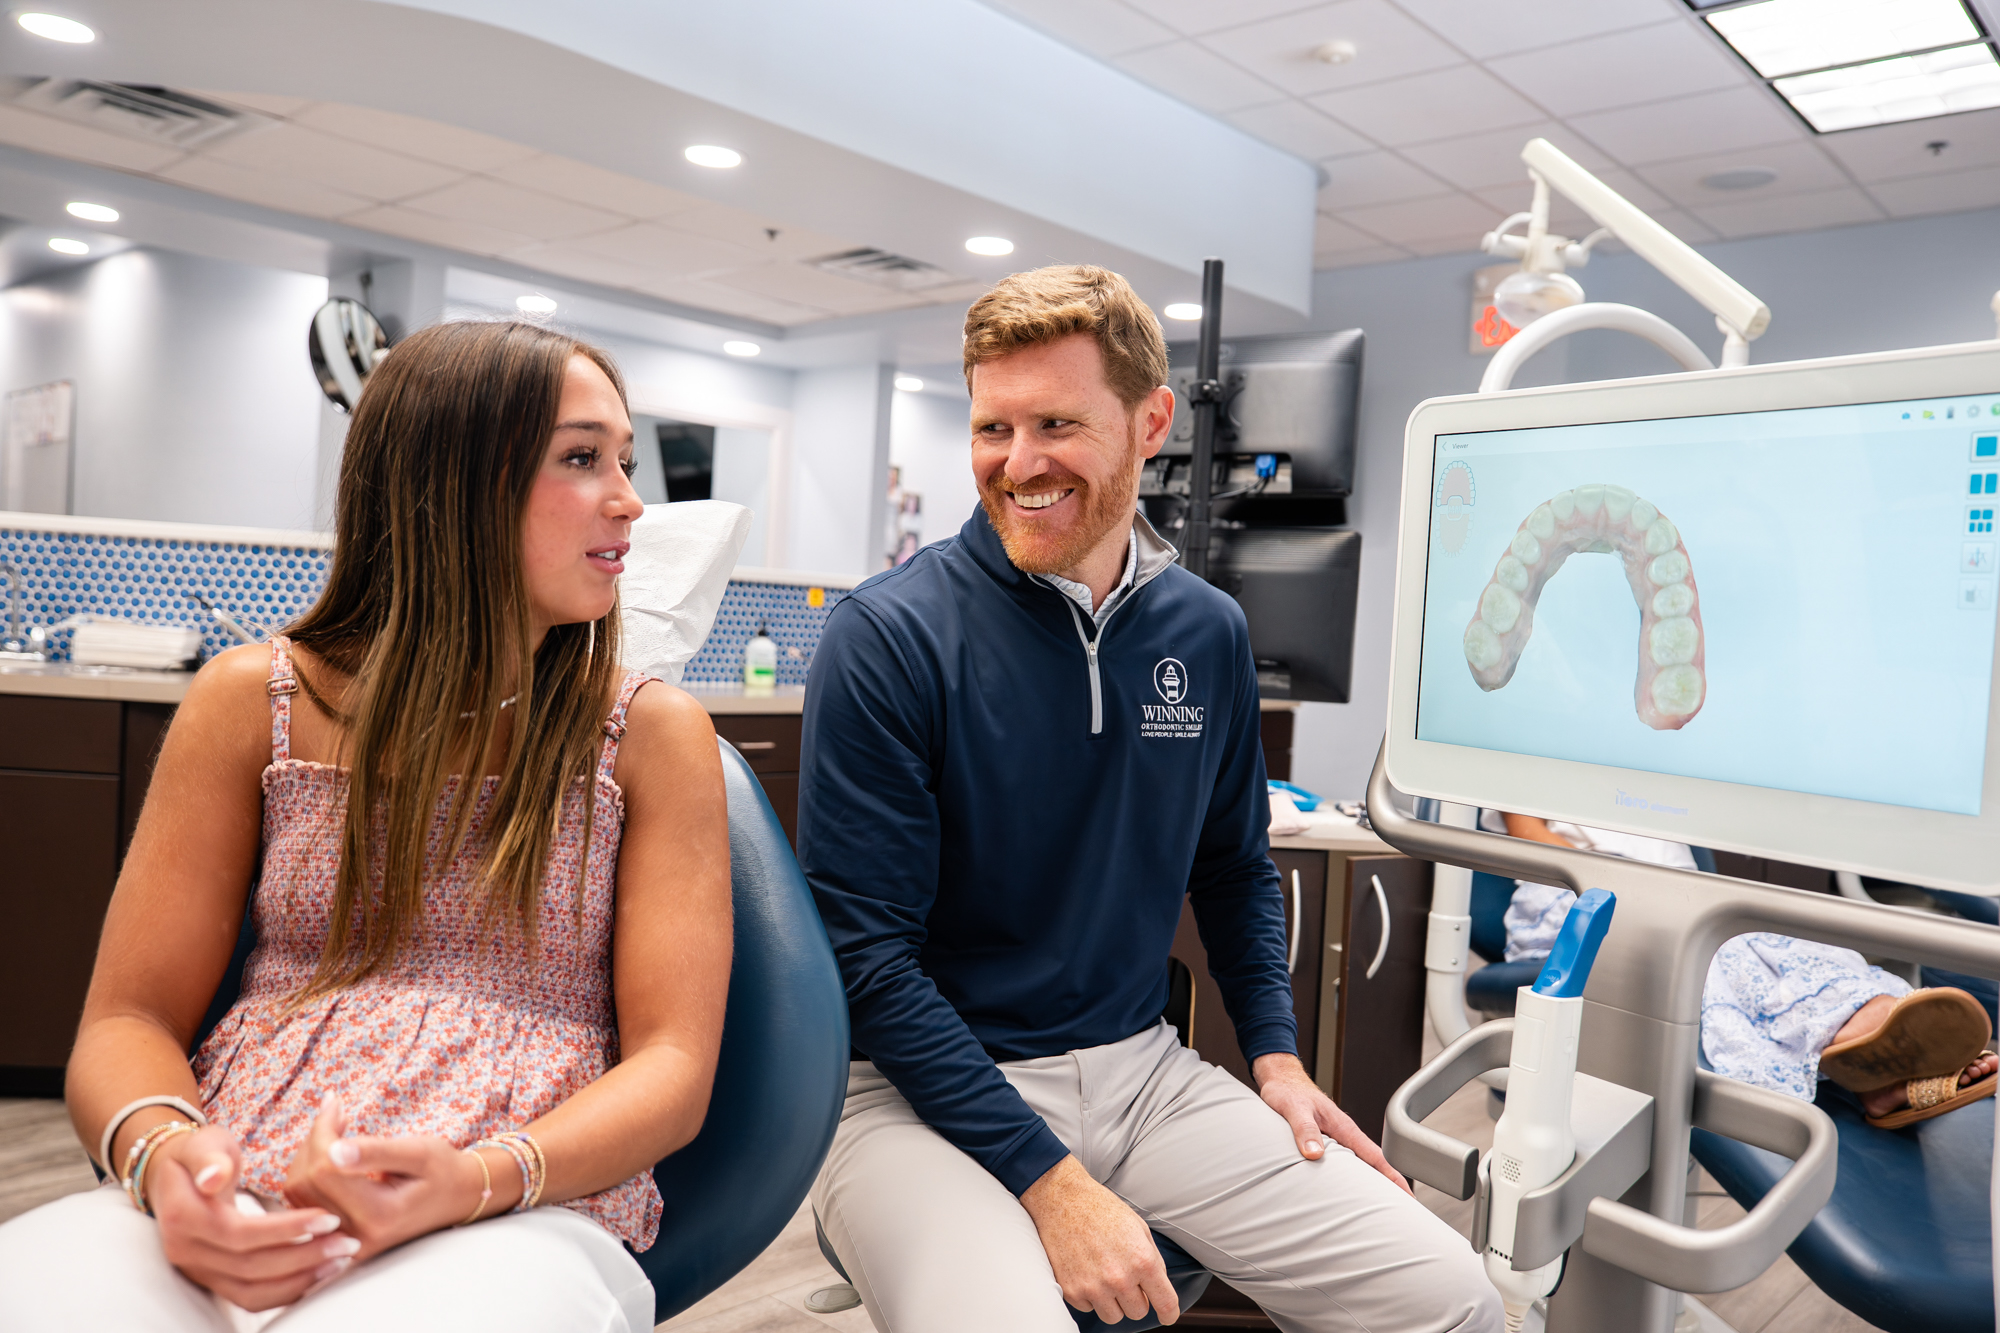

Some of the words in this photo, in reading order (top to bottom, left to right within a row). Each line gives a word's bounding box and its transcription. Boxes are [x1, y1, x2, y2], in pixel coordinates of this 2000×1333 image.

[1142, 705, 1204, 722] WINNING
[1141, 723, 1184, 731] ORTHODONTIC
[1185, 723, 1203, 731] SMILES
[1615, 788, 1648, 810] iTero
